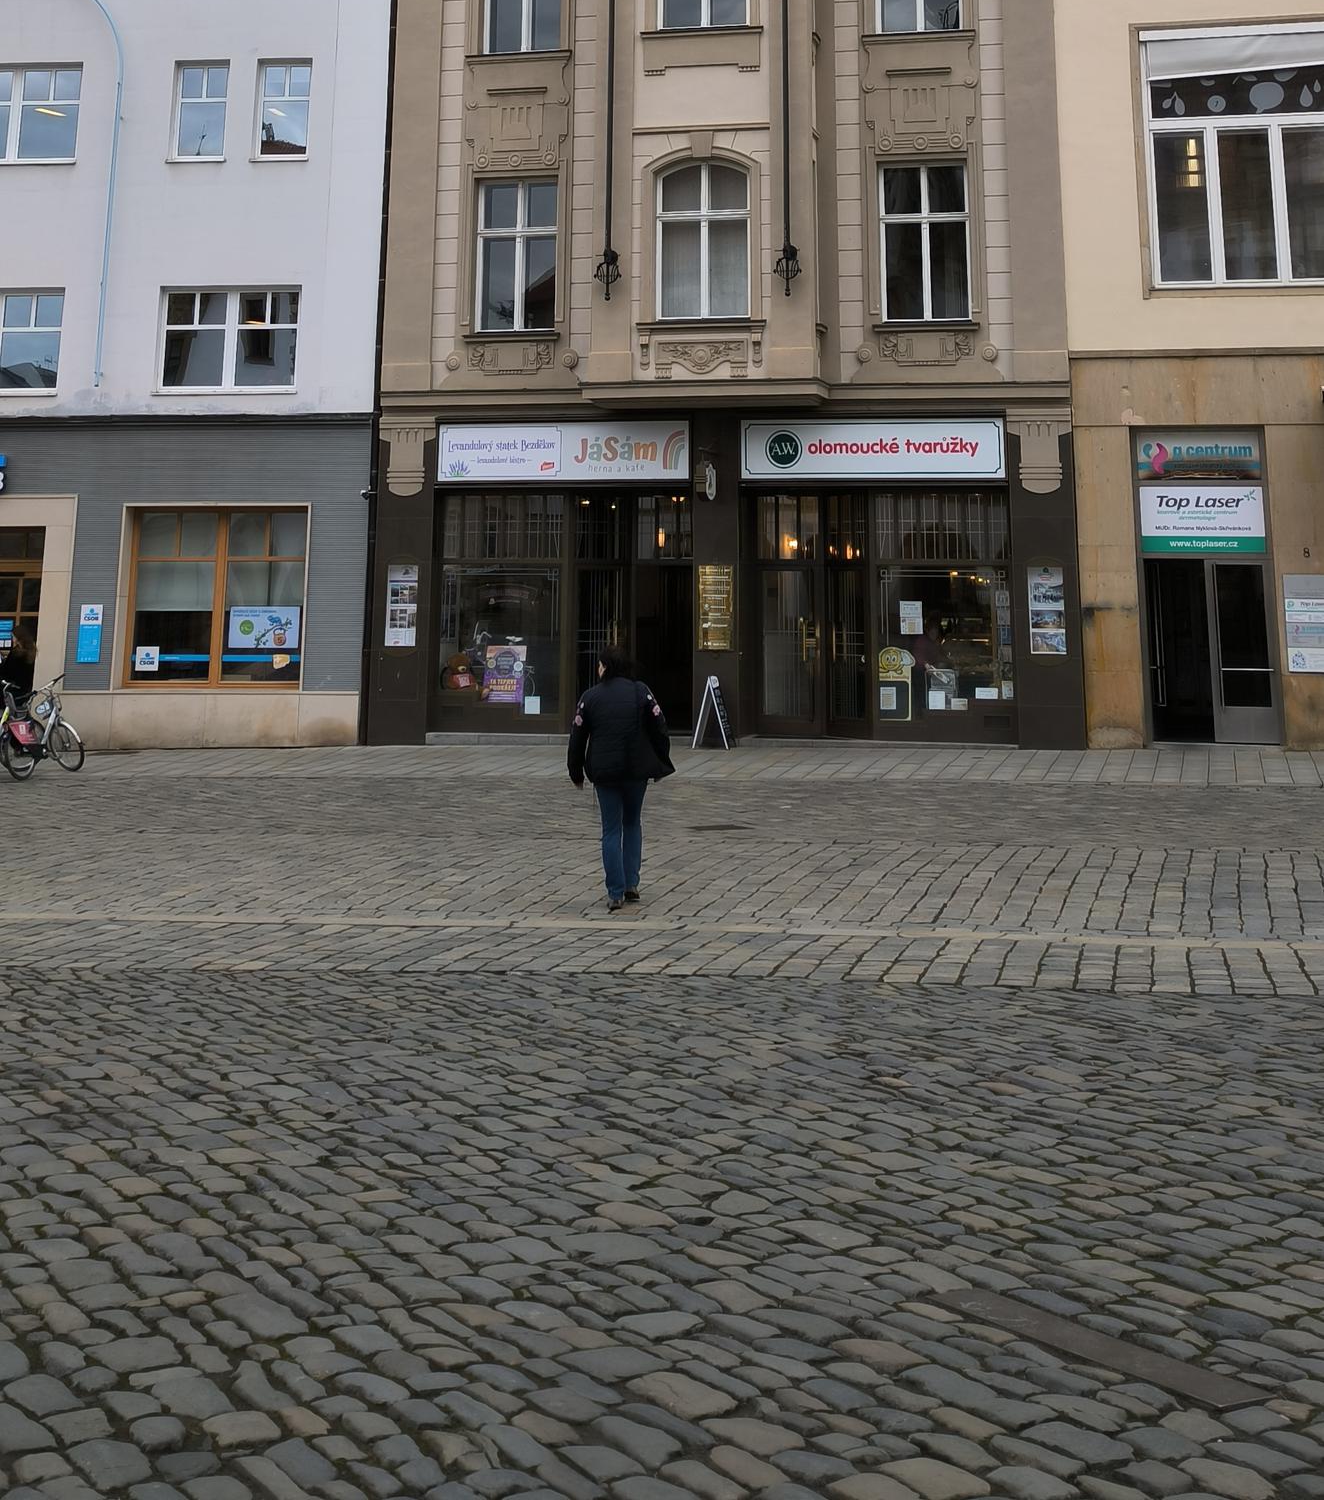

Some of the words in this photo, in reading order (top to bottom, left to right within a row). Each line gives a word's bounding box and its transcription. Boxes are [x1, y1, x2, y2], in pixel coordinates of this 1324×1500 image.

[448, 440, 494, 453] Levandulový
[495, 440, 519, 451] statek
[521, 439, 556, 452] Bezděkov
[574, 435, 658, 464] JáSám
[808, 437, 900, 455] olomoucké
[905, 436, 979, 457] tvarůžky
[1185, 444, 1253, 458] centrum
[588, 464, 613, 473] herna
[1156, 495, 1190, 511] Top
[1195, 496, 1244, 508] Laser
[1169, 540, 1239, 549] www.toplaser.cz
[1303, 547, 1311, 558] 8
